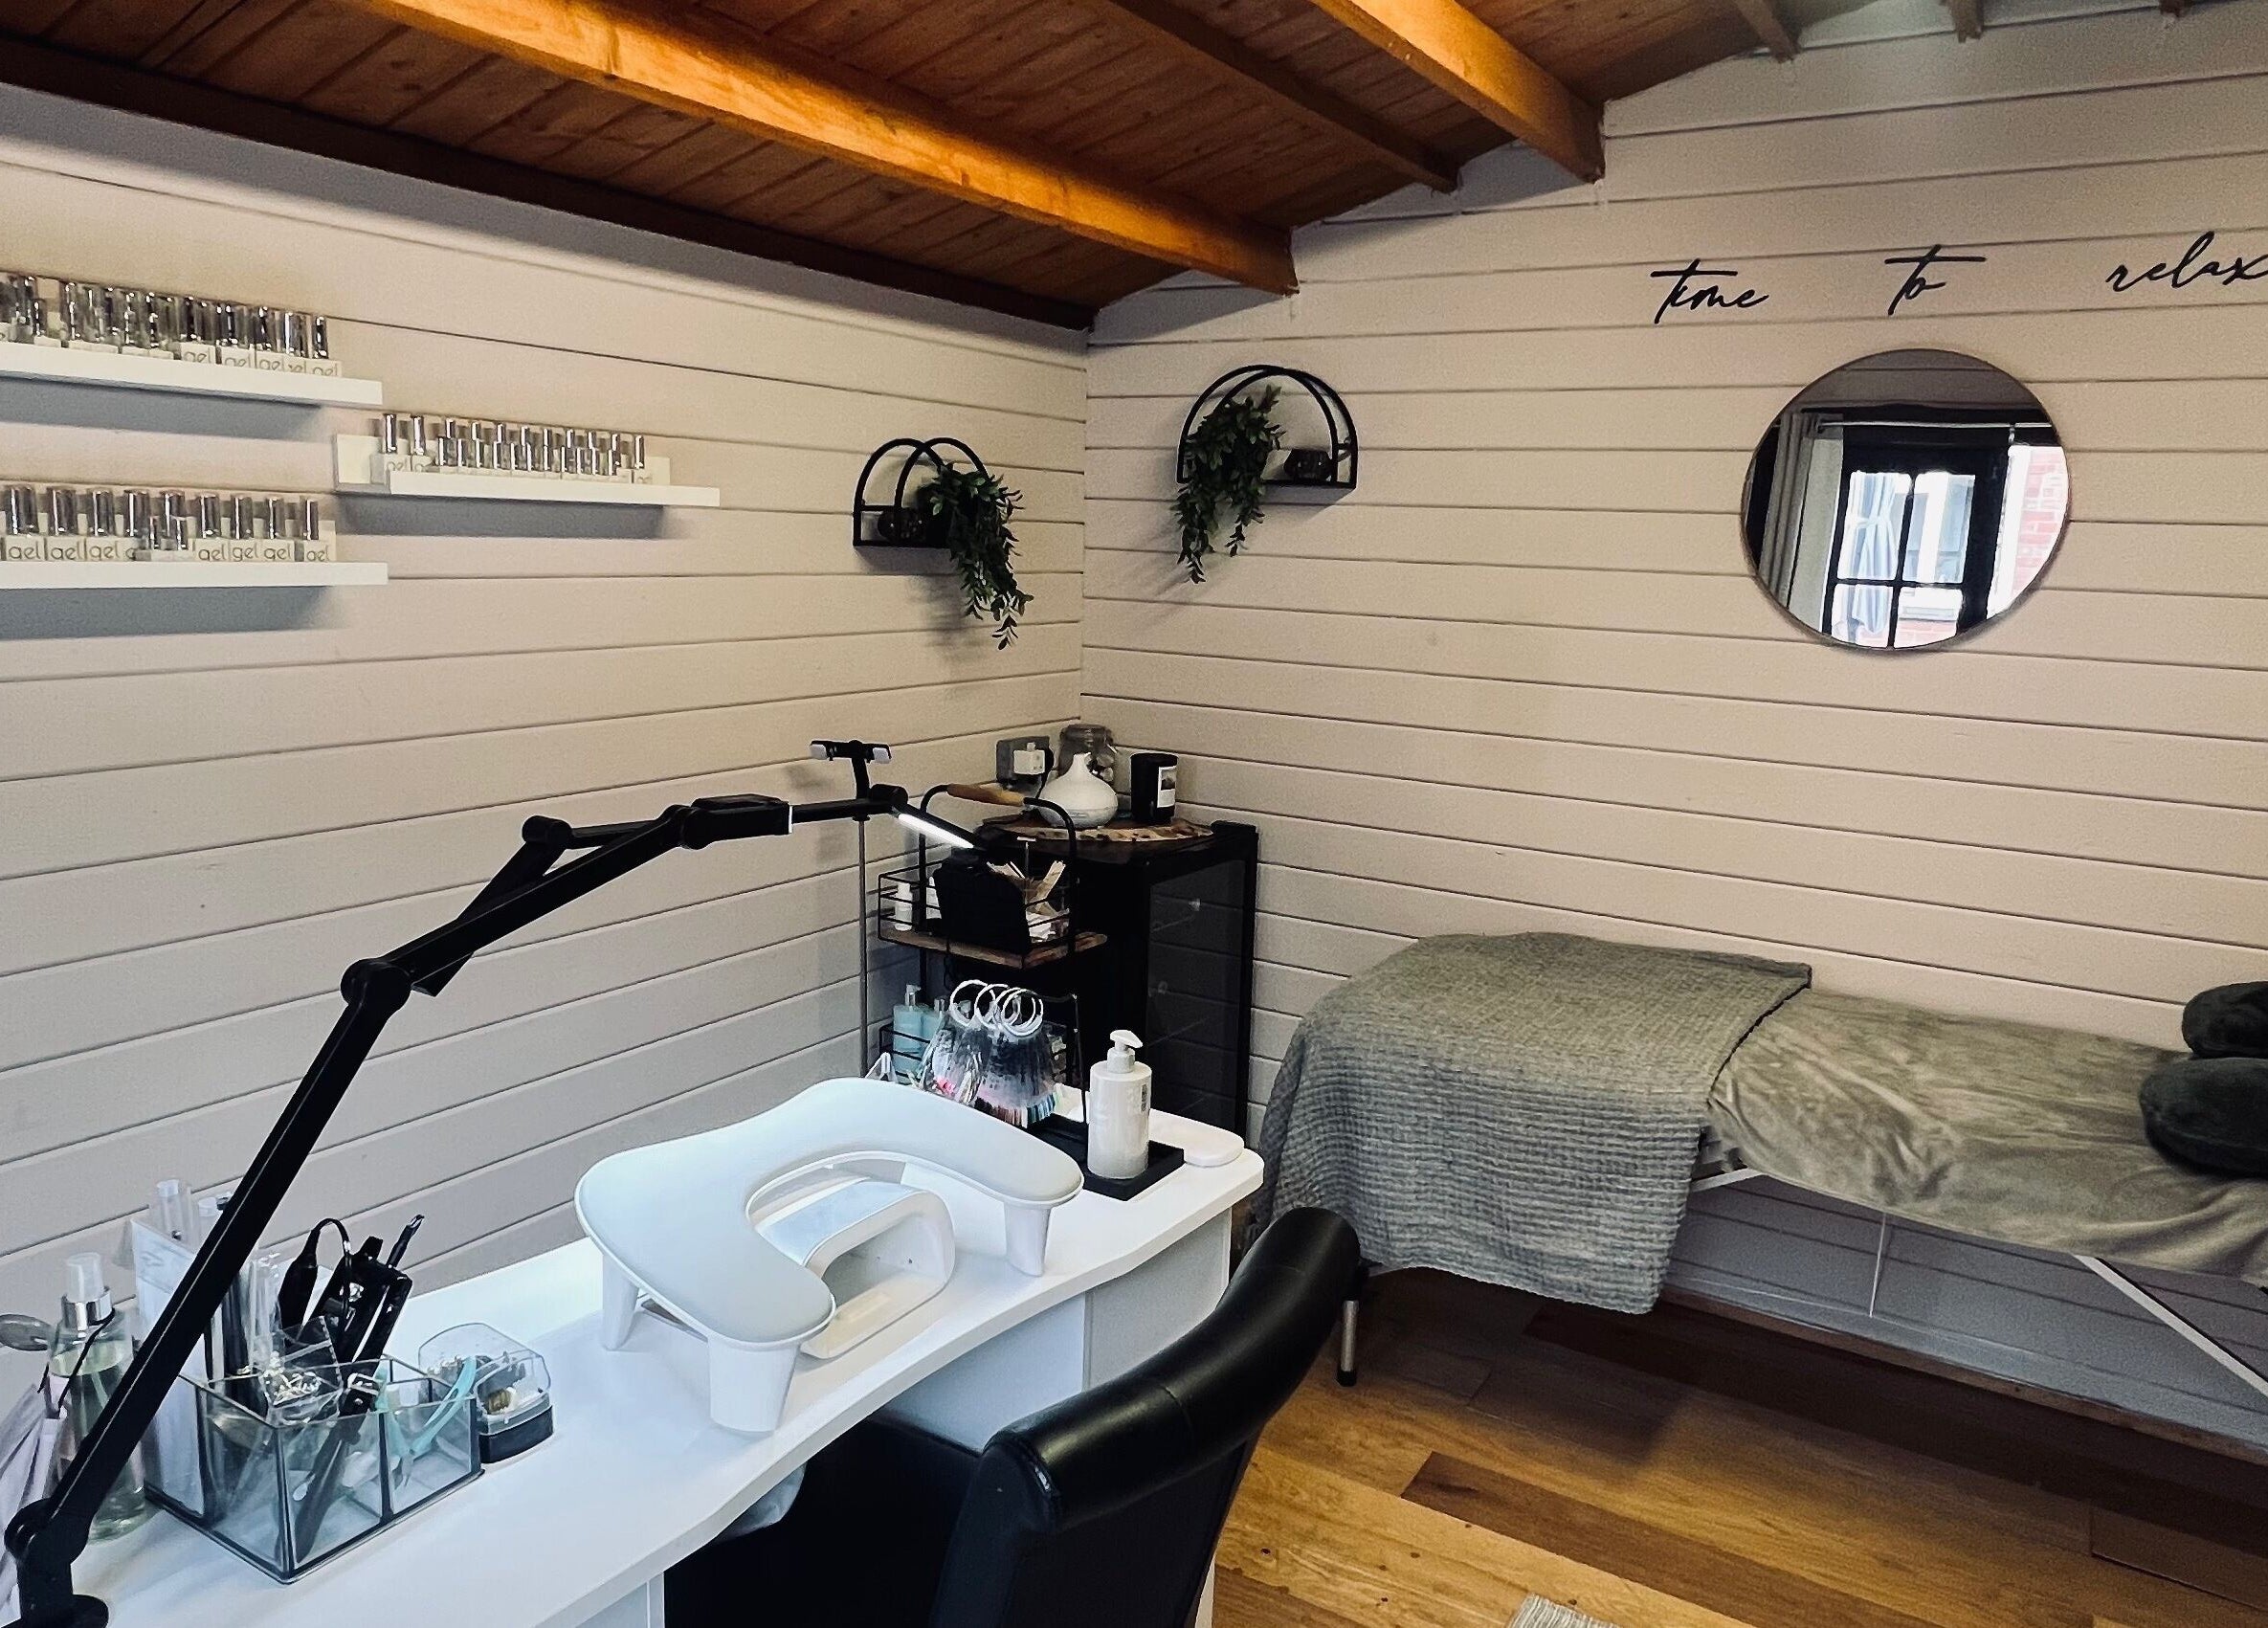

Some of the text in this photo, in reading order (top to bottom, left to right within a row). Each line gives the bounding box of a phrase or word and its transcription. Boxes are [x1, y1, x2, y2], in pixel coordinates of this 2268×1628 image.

[1650, 229, 2268, 324] time to relax
